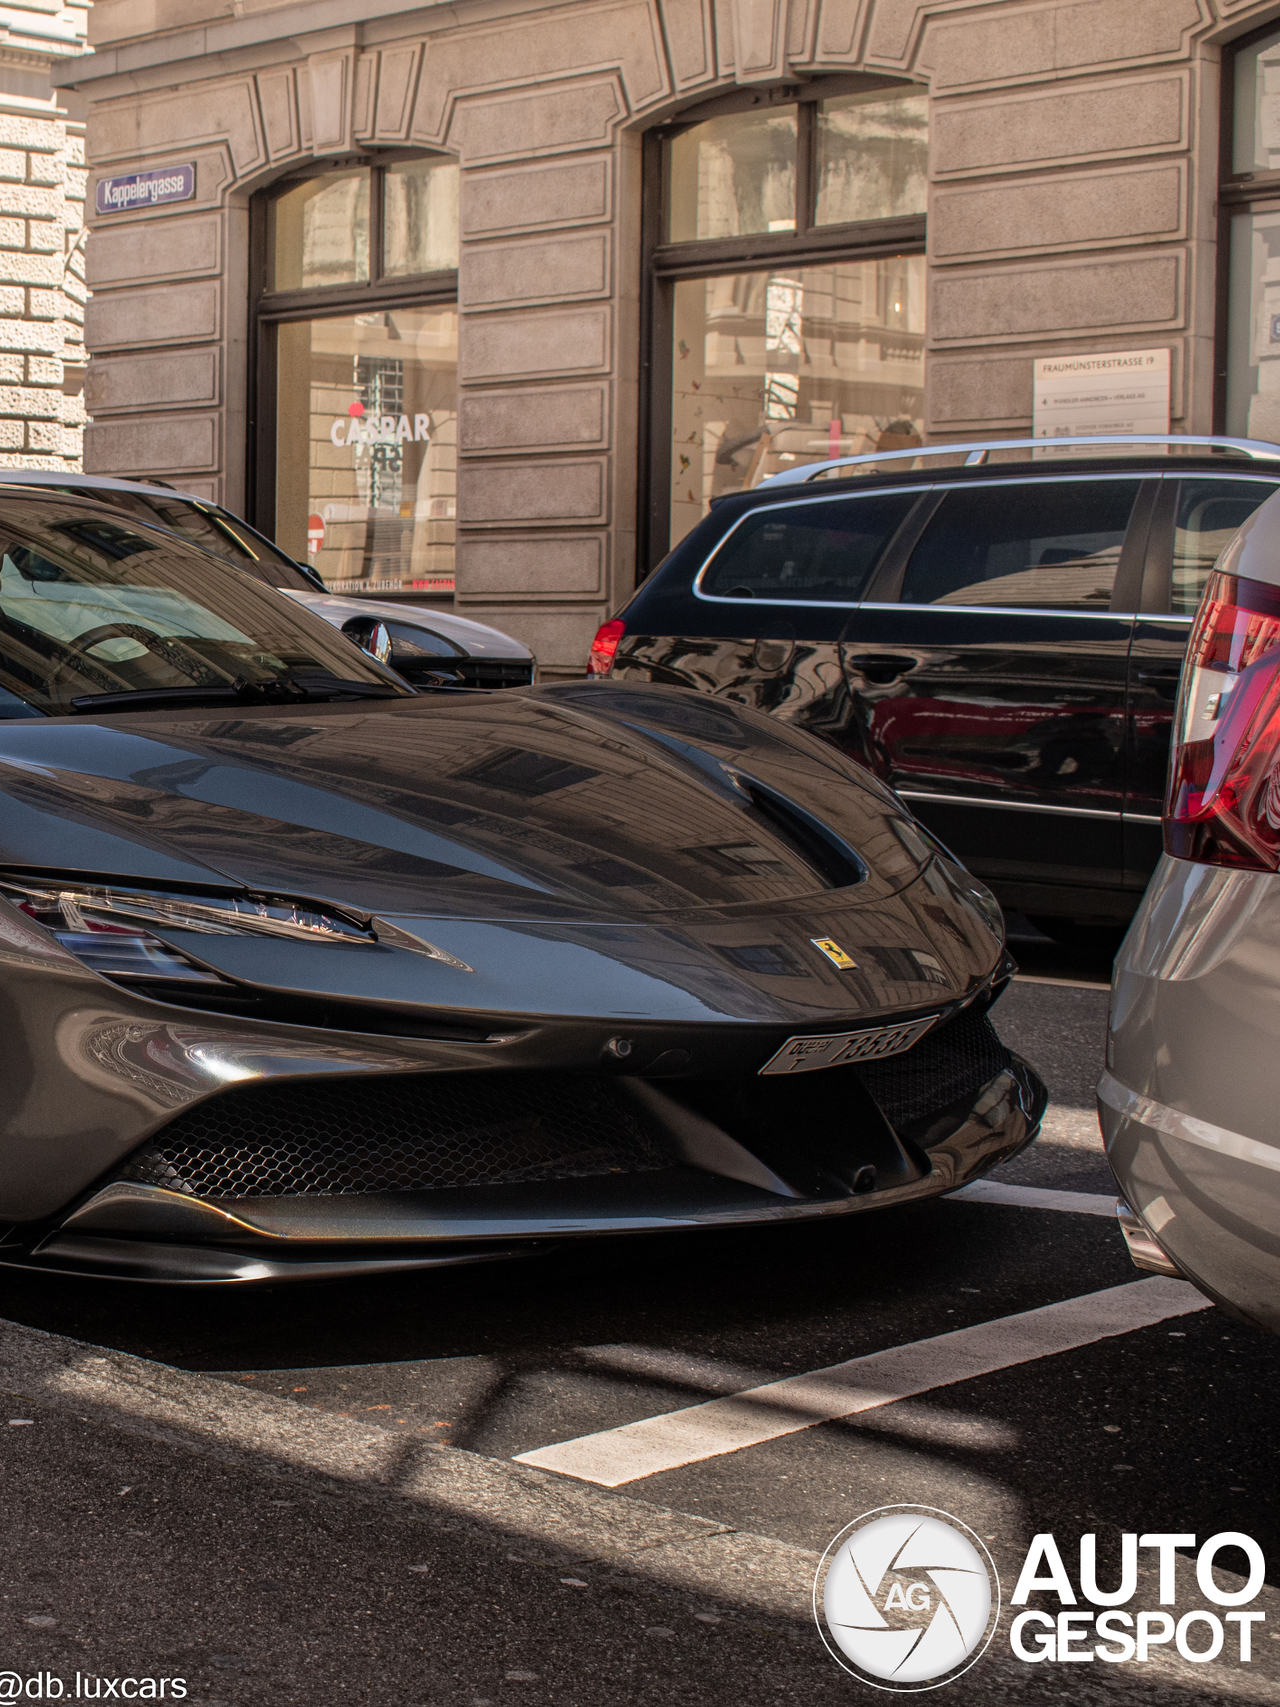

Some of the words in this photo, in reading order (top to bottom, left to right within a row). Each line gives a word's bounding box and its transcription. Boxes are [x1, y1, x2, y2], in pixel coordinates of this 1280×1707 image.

[104, 175, 184, 207] Kappelergasse
[1042, 357, 1143, 373] FRAUMÜNSTERSTRASSE
[1146, 356, 1155, 365] 19
[1042, 398, 1048, 406] 4
[330, 413, 431, 447] CASPAR
[373, 578, 403, 590] ZUBEHÖR
[829, 1026, 918, 1063] 73535
[788, 1057, 806, 1070] T
